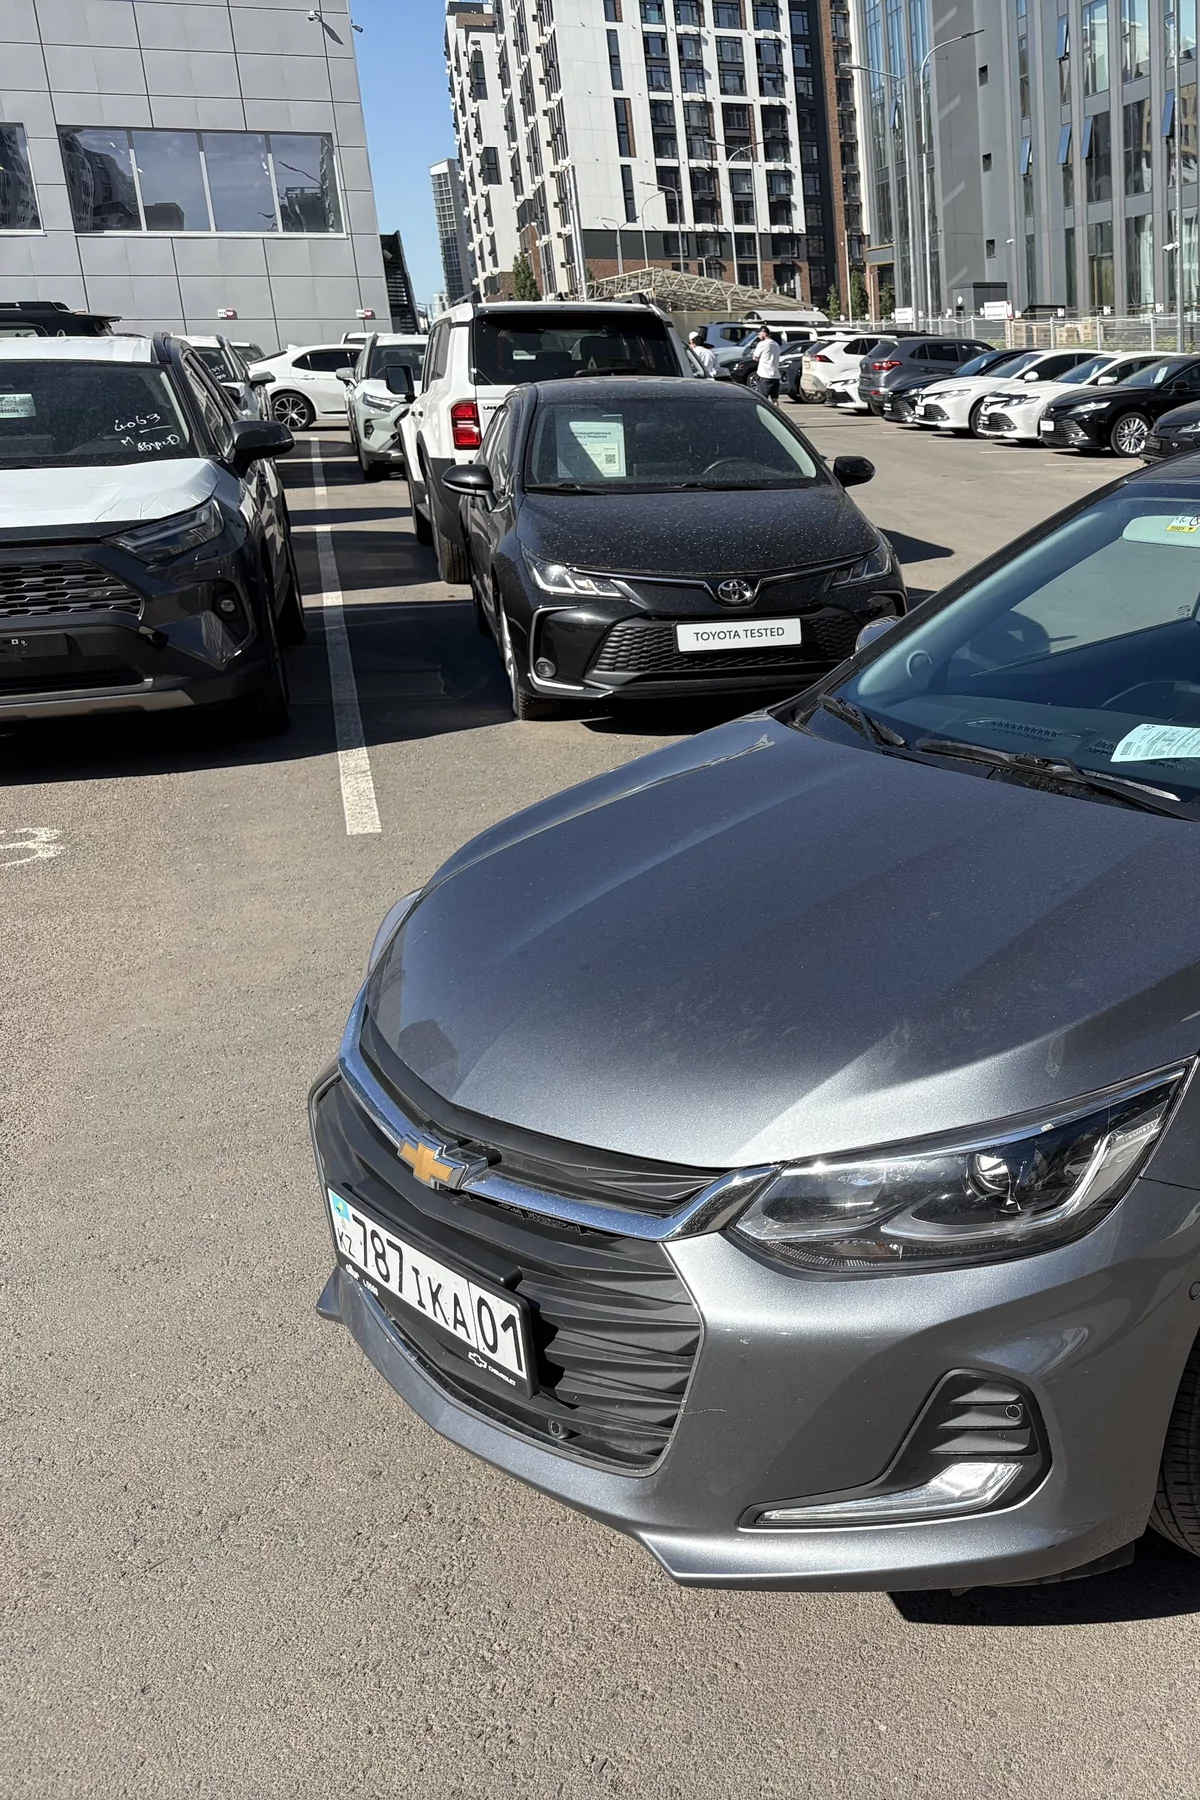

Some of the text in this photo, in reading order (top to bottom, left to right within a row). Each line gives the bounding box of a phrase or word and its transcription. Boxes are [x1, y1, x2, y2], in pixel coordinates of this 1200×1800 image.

[693, 627, 785, 642] TOYOTA TESTED
[336, 1227, 356, 1258] KZ
[352, 1213, 524, 1373] 787 IKA 01
